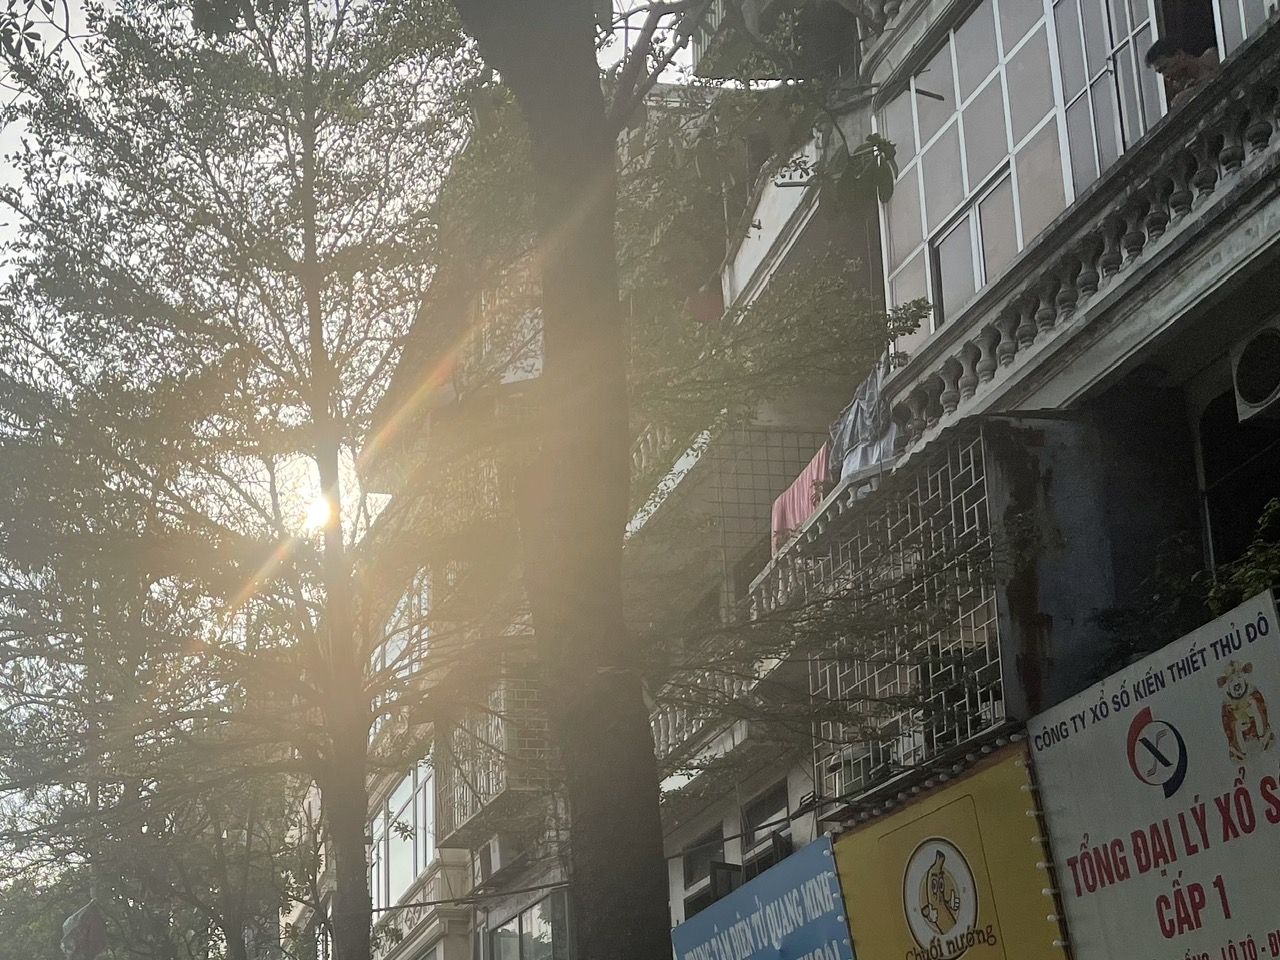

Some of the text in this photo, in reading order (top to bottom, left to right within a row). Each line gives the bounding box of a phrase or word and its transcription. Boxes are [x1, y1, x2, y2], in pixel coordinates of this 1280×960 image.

[1034, 611, 1270, 752] CÔNG TY XỔ SỐ KIẾN THIẾT THỦ ĐÔ
[1066, 765, 1280, 897] TỔNG ĐẠI LÝ XỔ S
[750, 896, 769, 951] TỬ
[765, 889, 805, 951] QUANG
[946, 924, 998, 954] nướng
[1155, 870, 1232, 939] CẤP 1
